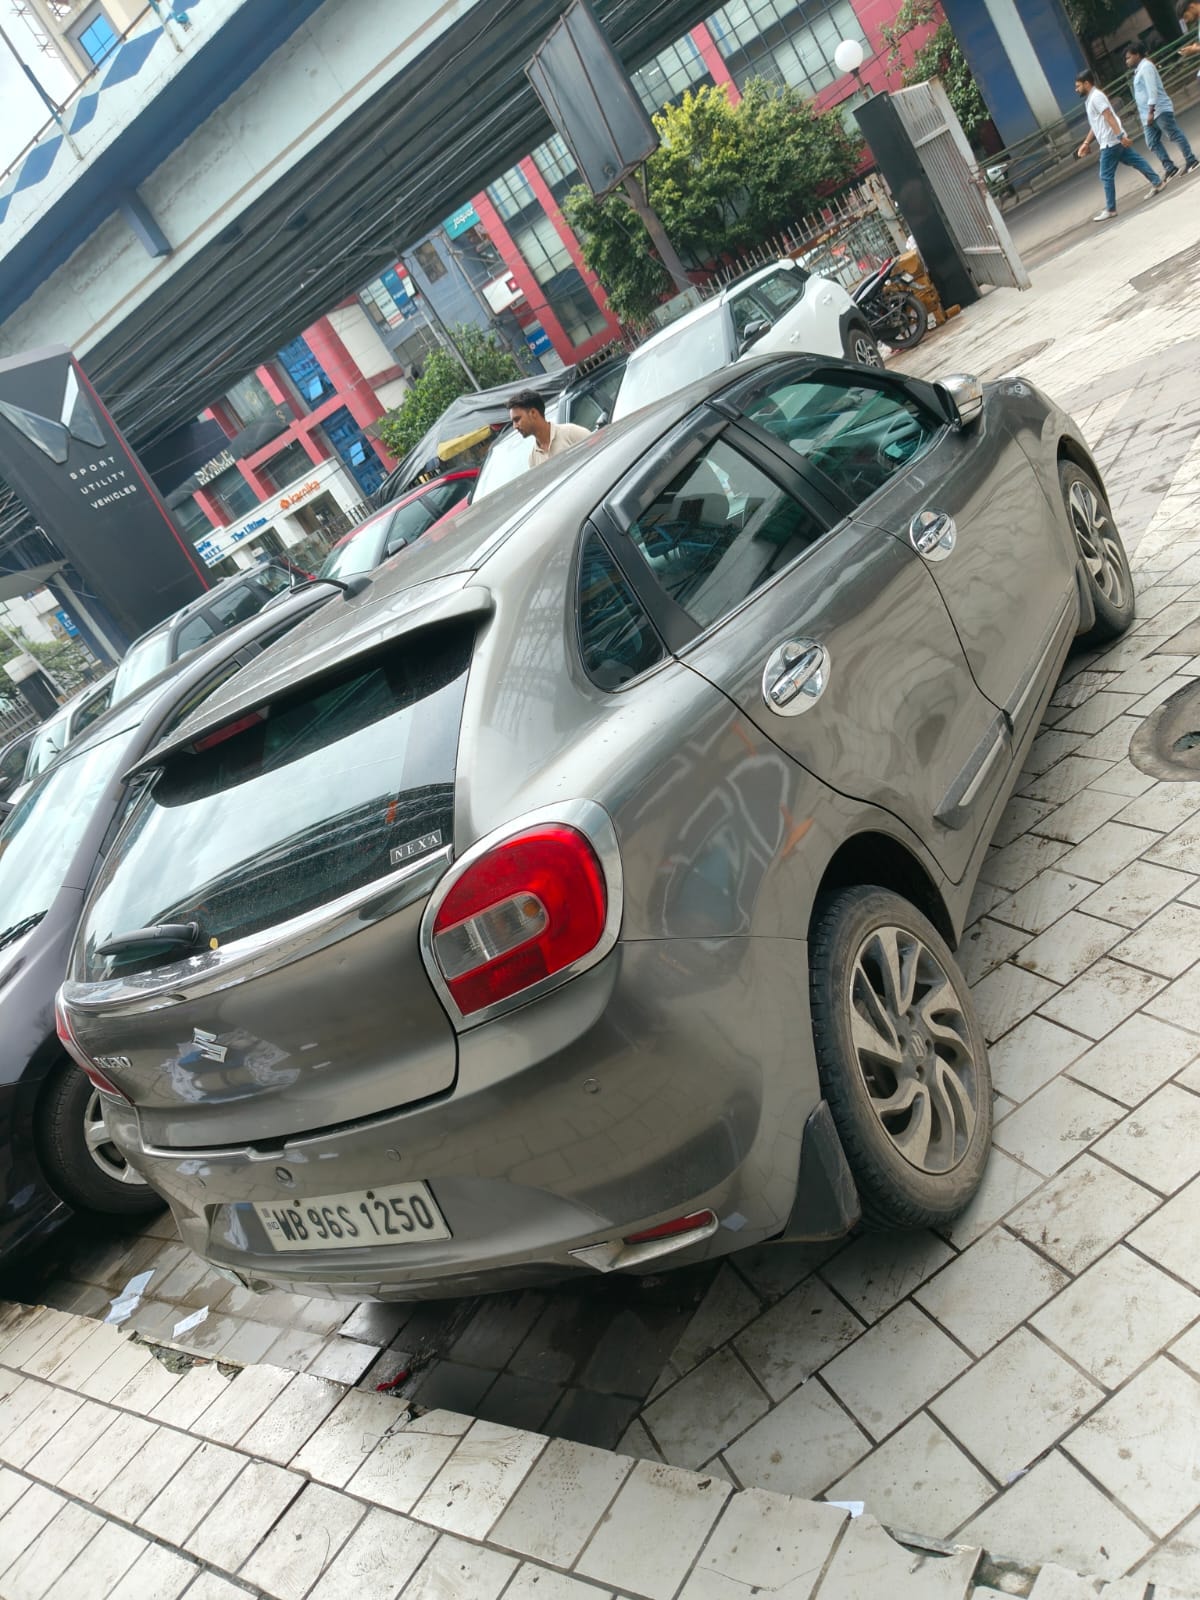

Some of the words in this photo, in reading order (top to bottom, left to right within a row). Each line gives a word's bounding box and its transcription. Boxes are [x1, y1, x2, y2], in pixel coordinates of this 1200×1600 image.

[69, 456, 115, 480] SPORT
[80, 470, 126, 495] UTILITY
[90, 484, 137, 509] VEHICLES
[395, 834, 439, 860] NEXA
[272, 1209, 309, 1241] WB
[307, 1206, 359, 1239] 96S
[360, 1195, 434, 1235] 1250
